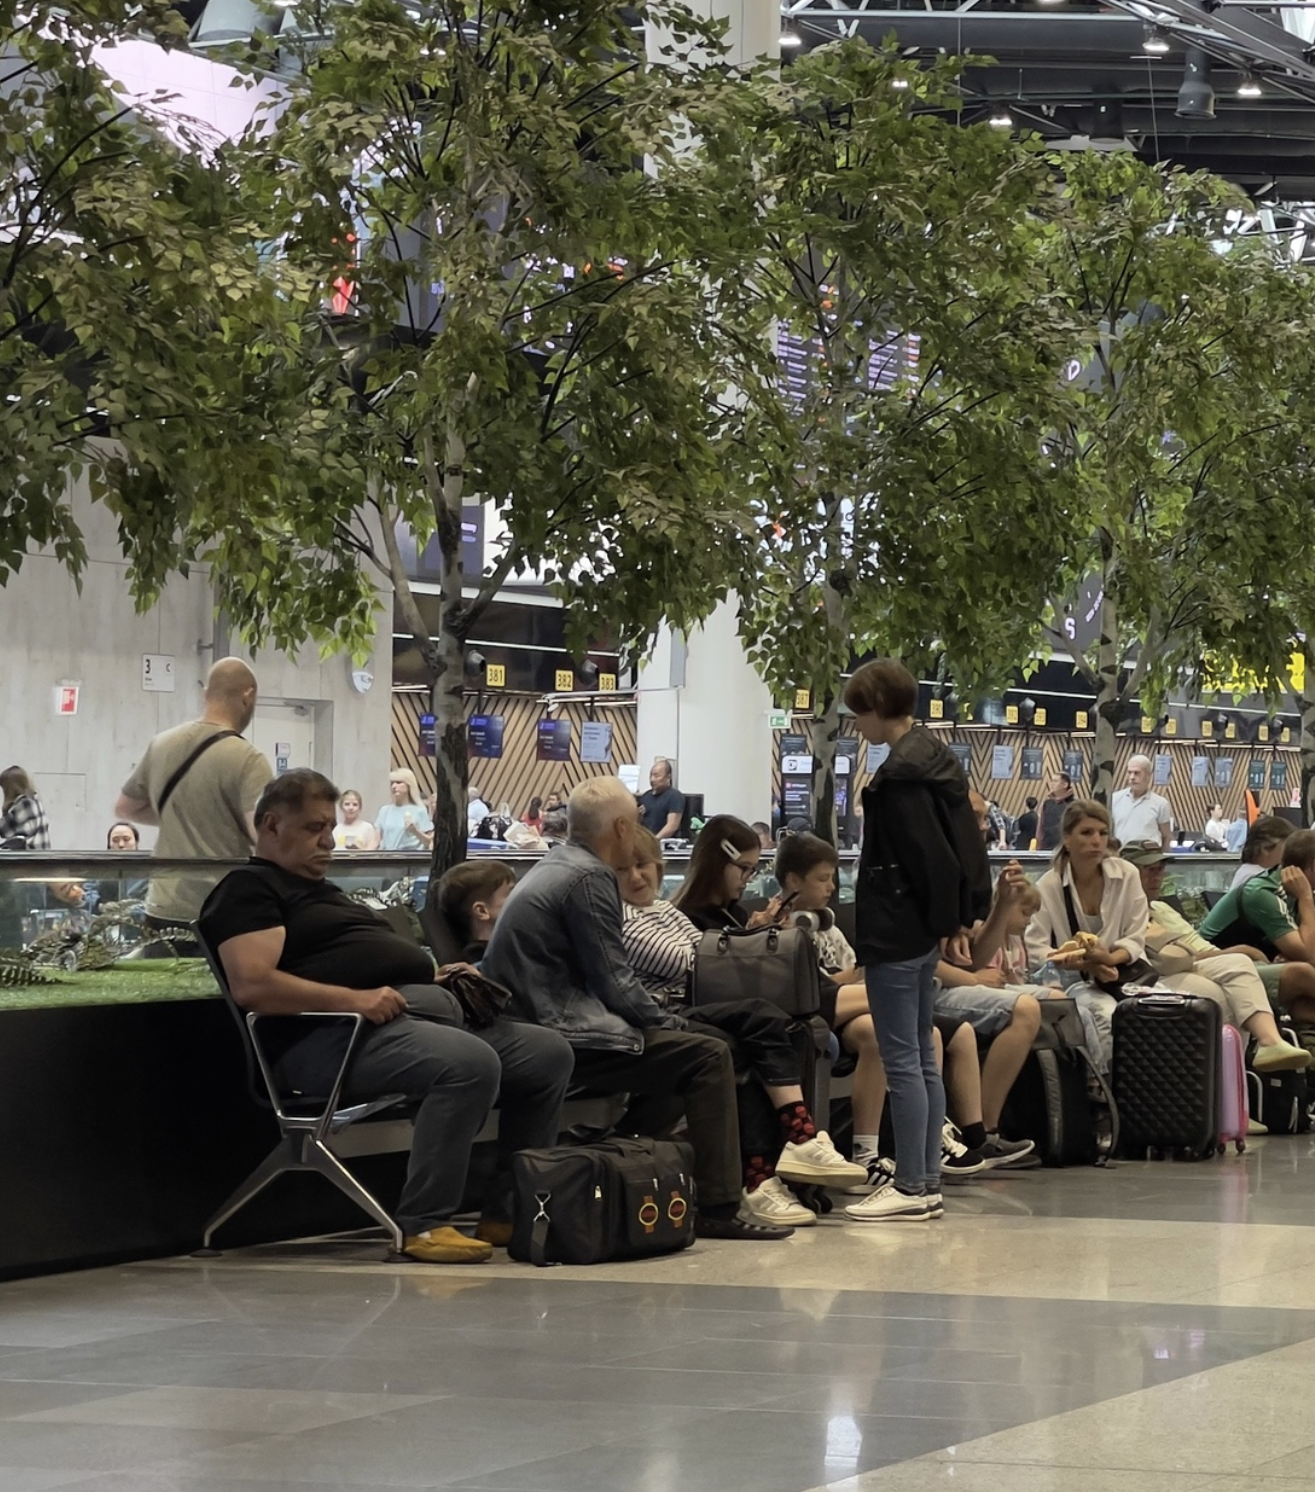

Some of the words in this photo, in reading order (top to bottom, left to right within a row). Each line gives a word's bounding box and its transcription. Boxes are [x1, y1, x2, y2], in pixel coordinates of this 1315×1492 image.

[145, 659, 151, 674] 3
[489, 669, 503, 682] 381
[558, 674, 572, 688] 382
[601, 678, 614, 690] 383
